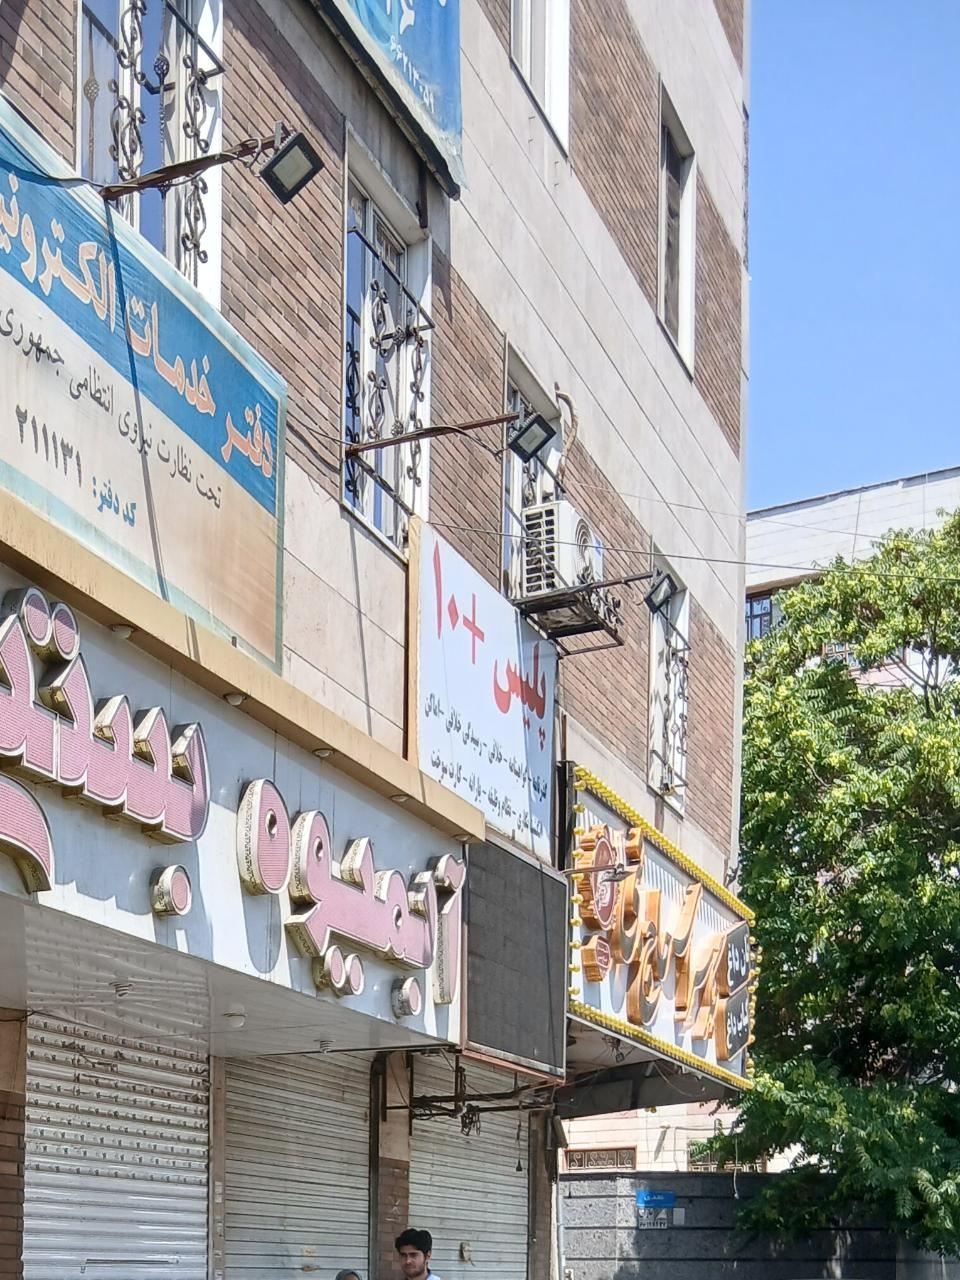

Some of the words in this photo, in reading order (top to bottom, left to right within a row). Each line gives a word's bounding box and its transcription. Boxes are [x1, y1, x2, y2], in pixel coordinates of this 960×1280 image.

[127, 296, 216, 417] خدمات
[69, 365, 114, 417] انتظامی
[14, 403, 82, 488] ۲۱۱۱۳۱
[118, 410, 153, 455] نیروی
[156, 439, 192, 483] نظارت
[221, 403, 273, 479] دفتر
[123, 502, 137, 528] کد
[195, 473, 222, 509] تحت
[492, 641, 546, 753] پلیس
[237, 778, 470, 1020] آبمیوه
